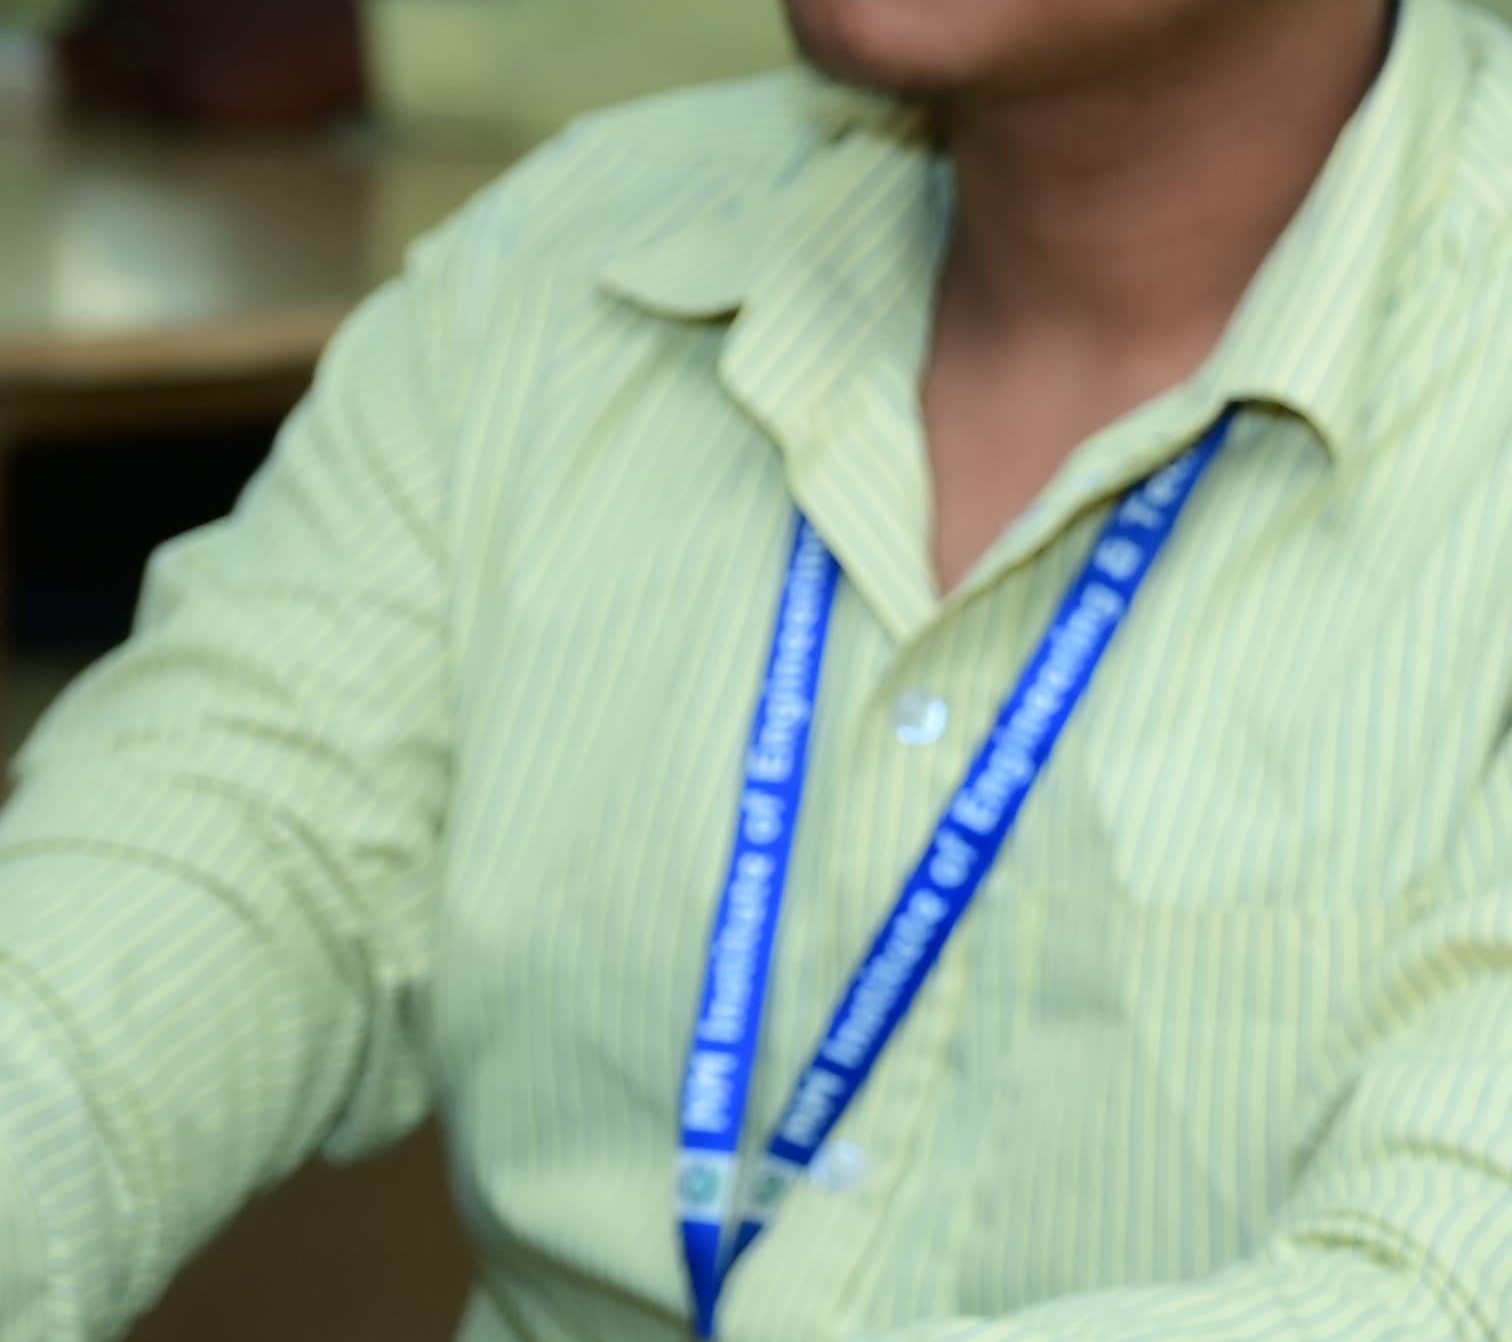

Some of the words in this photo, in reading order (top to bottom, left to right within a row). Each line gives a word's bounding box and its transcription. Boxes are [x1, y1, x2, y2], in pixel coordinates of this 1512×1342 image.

[951, 582, 1124, 834] Engineering
[701, 851, 775, 1043] Institute
[742, 789, 785, 845] of
[928, 826, 978, 889] of
[823, 886, 949, 1070] Institute
